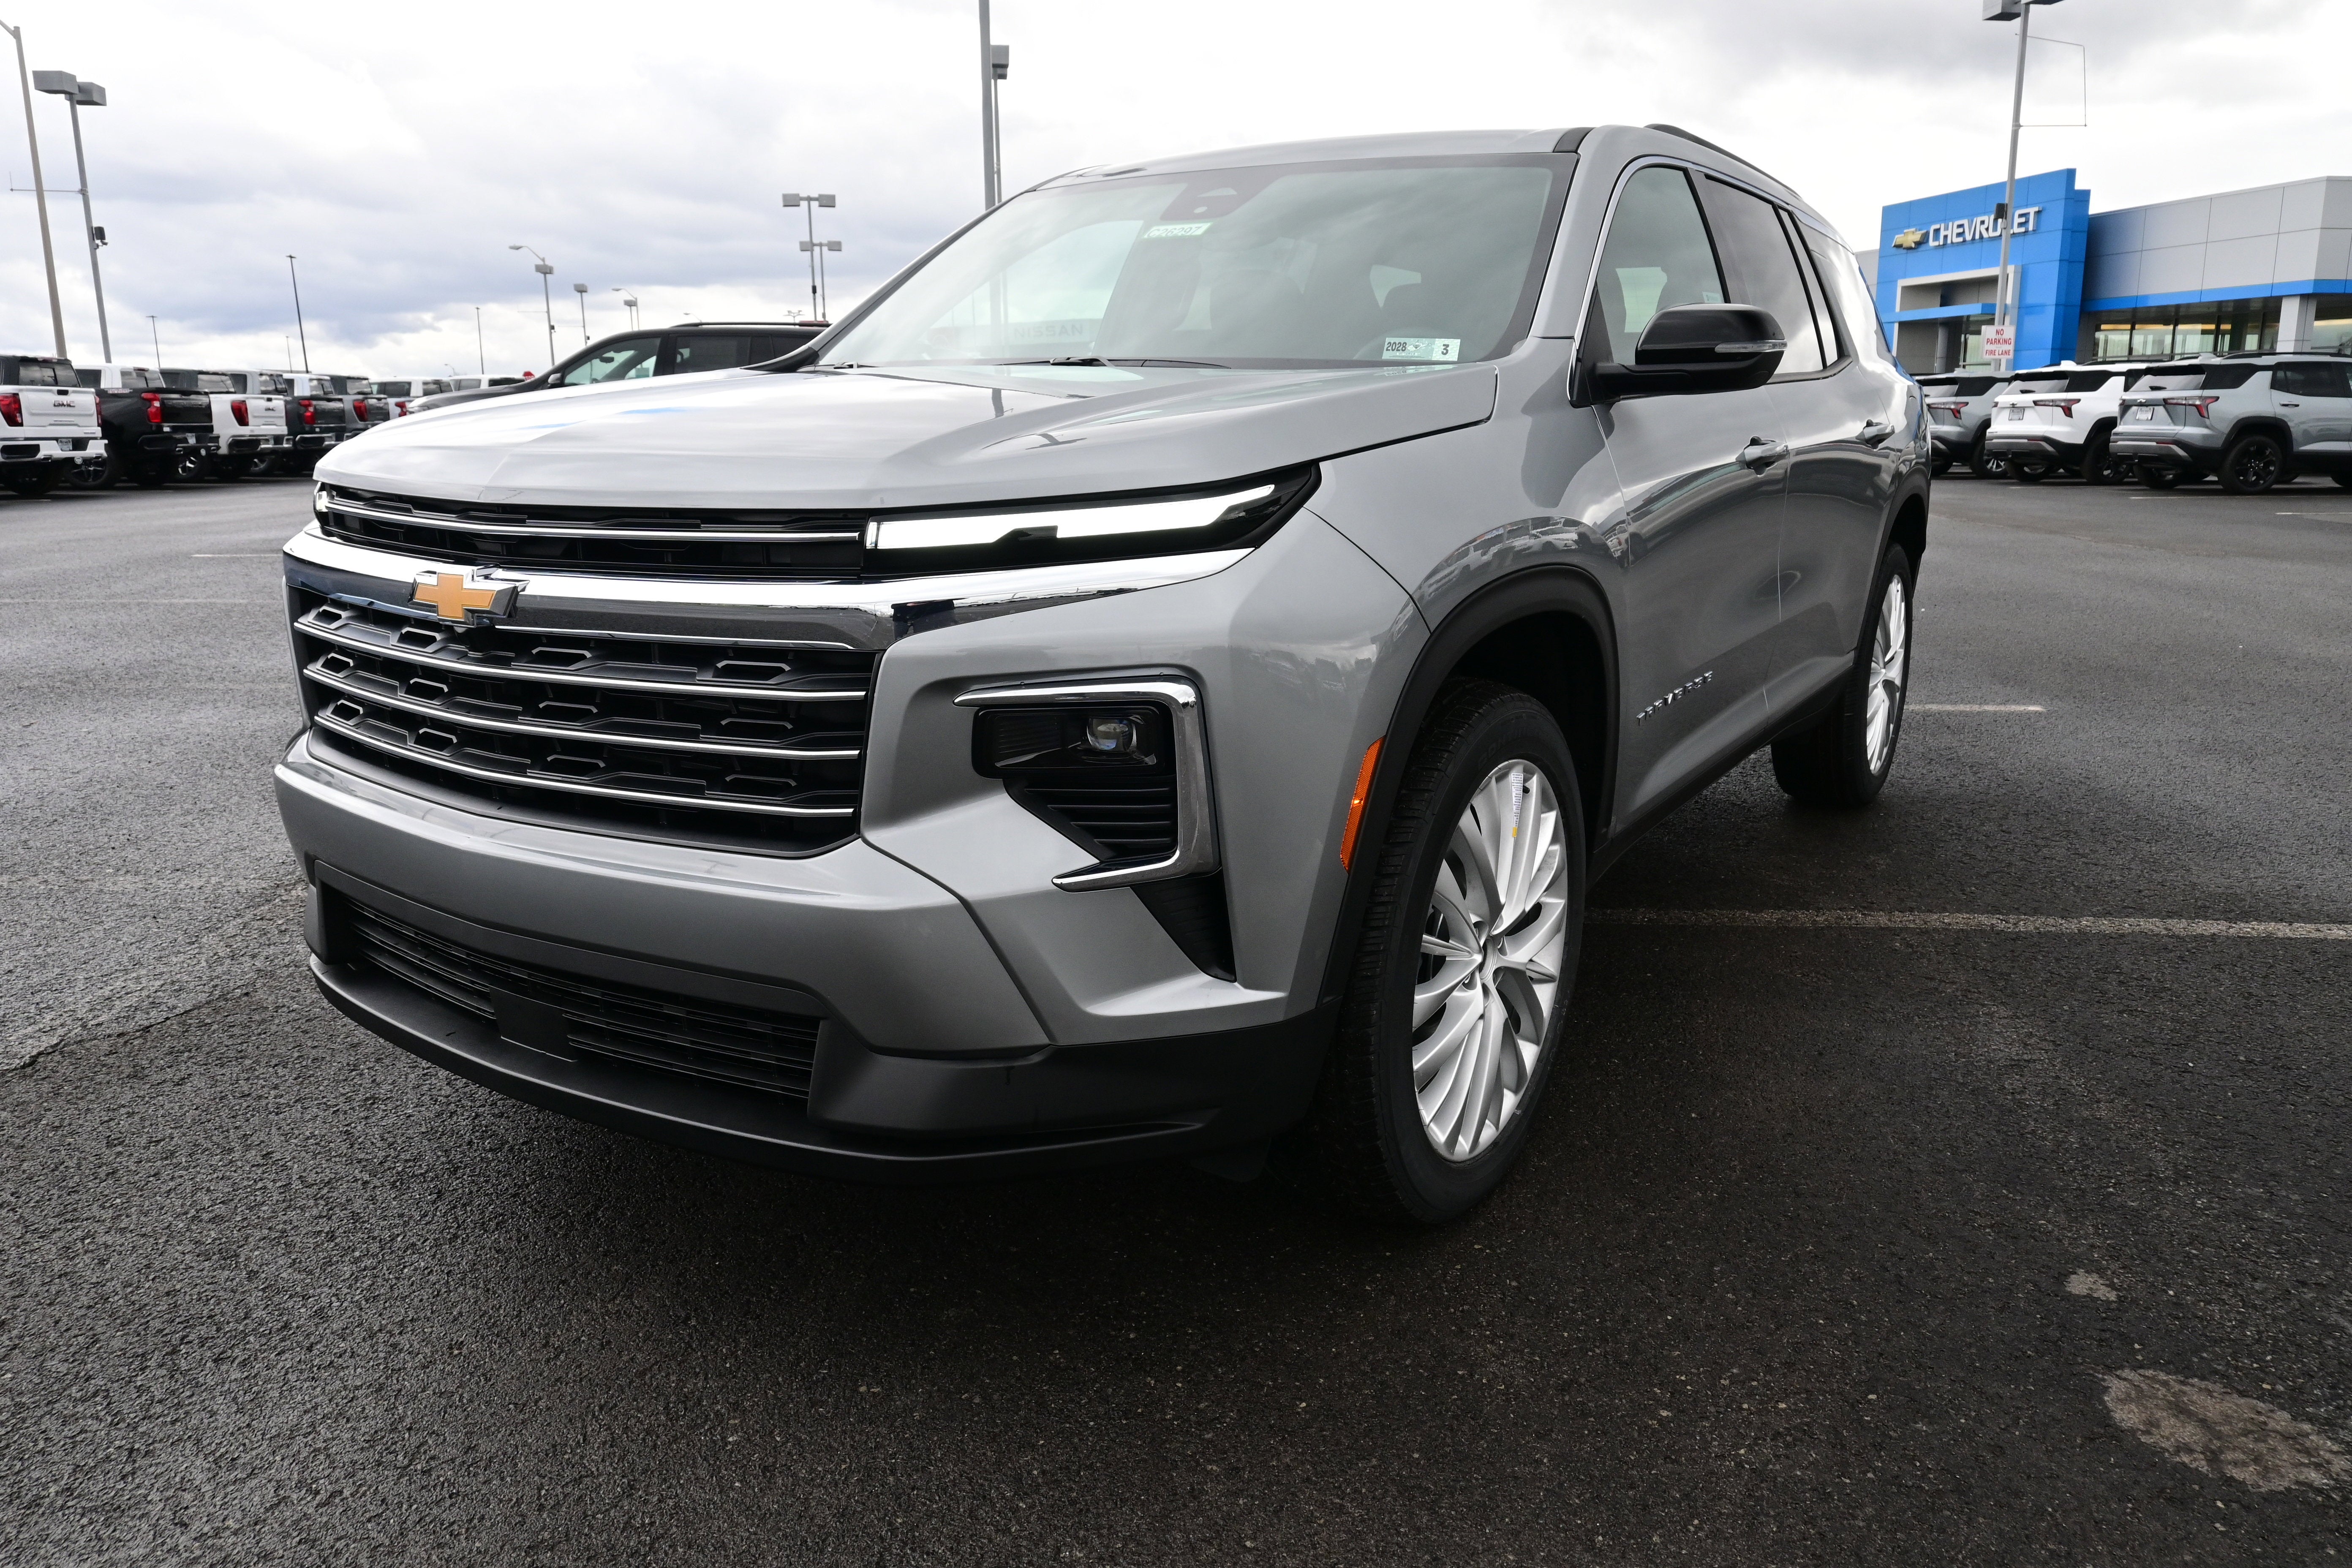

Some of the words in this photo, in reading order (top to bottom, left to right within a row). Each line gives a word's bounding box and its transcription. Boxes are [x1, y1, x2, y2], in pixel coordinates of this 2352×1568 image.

[1929, 206, 2041, 246] CHEVROET
[1014, 324, 1083, 339] NISSAN
[1386, 341, 1407, 352] 2028
[1441, 343, 1450, 355] 3
[1636, 671, 1713, 726] TRAVERSE
